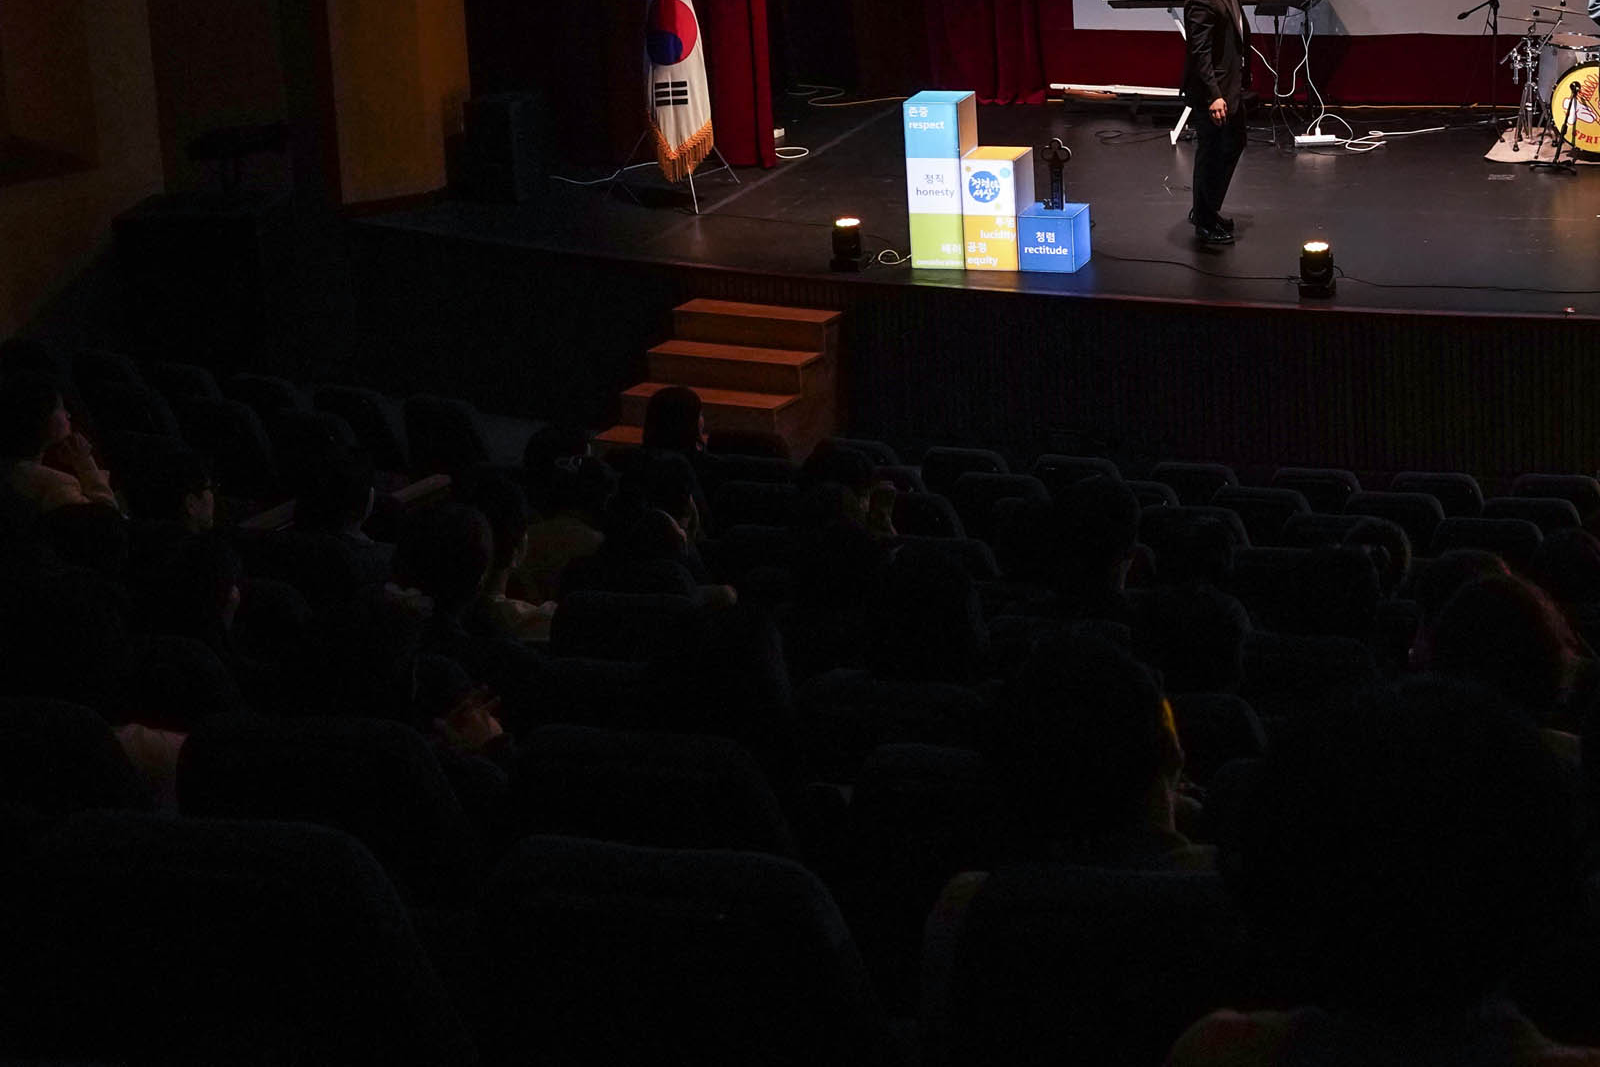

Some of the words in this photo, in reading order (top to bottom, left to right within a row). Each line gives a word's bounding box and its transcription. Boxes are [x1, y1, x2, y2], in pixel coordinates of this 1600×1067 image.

[908, 120, 945, 130] respect
[924, 173, 944, 184] 정직
[916, 186, 955, 198] honesty
[980, 229, 1016, 242] lucidity
[1035, 231, 1056, 243] 청렴
[1024, 244, 1068, 256] rectitude
[967, 255, 998, 267] equity
